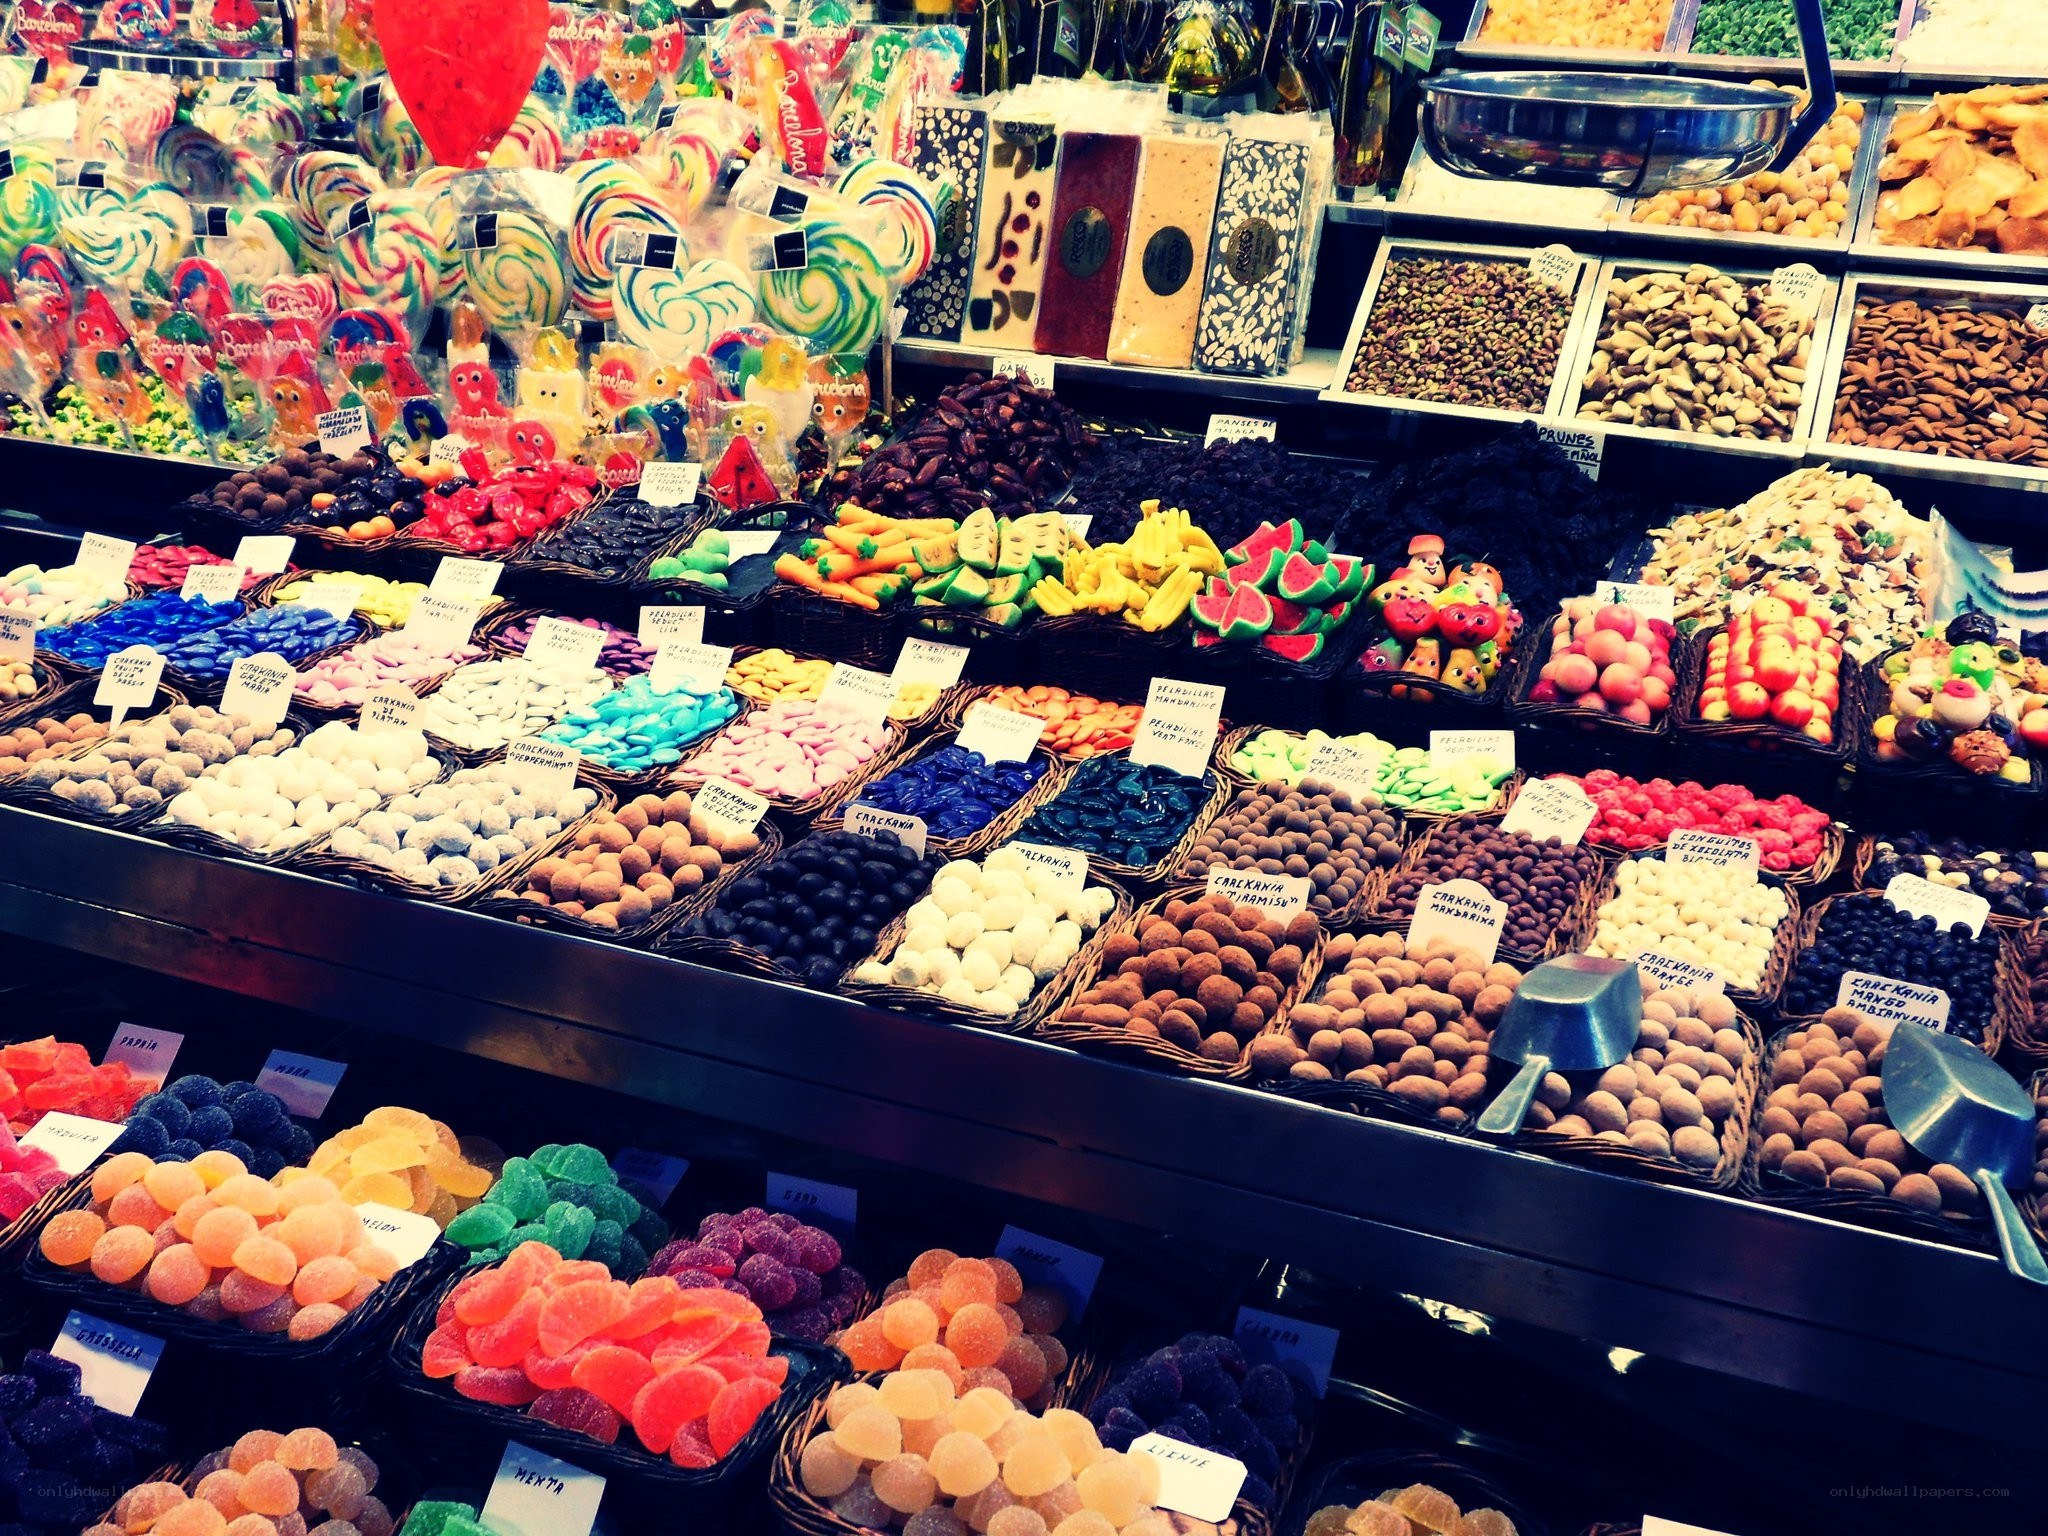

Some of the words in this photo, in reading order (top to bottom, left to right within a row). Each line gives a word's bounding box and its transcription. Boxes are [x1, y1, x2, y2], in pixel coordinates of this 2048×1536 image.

[16, 7, 77, 34] Barcelona
[775, 69, 822, 175] Barcelona
[1539, 427, 1595, 447] PRUNES
[1156, 684, 1215, 699] PELADILLAS
[1679, 832, 1753, 852] CONGUITOS
[1429, 901, 1496, 928] MANDARINA
[1850, 988, 1907, 1011] MANGO
[514, 1466, 565, 1495] MENTA
